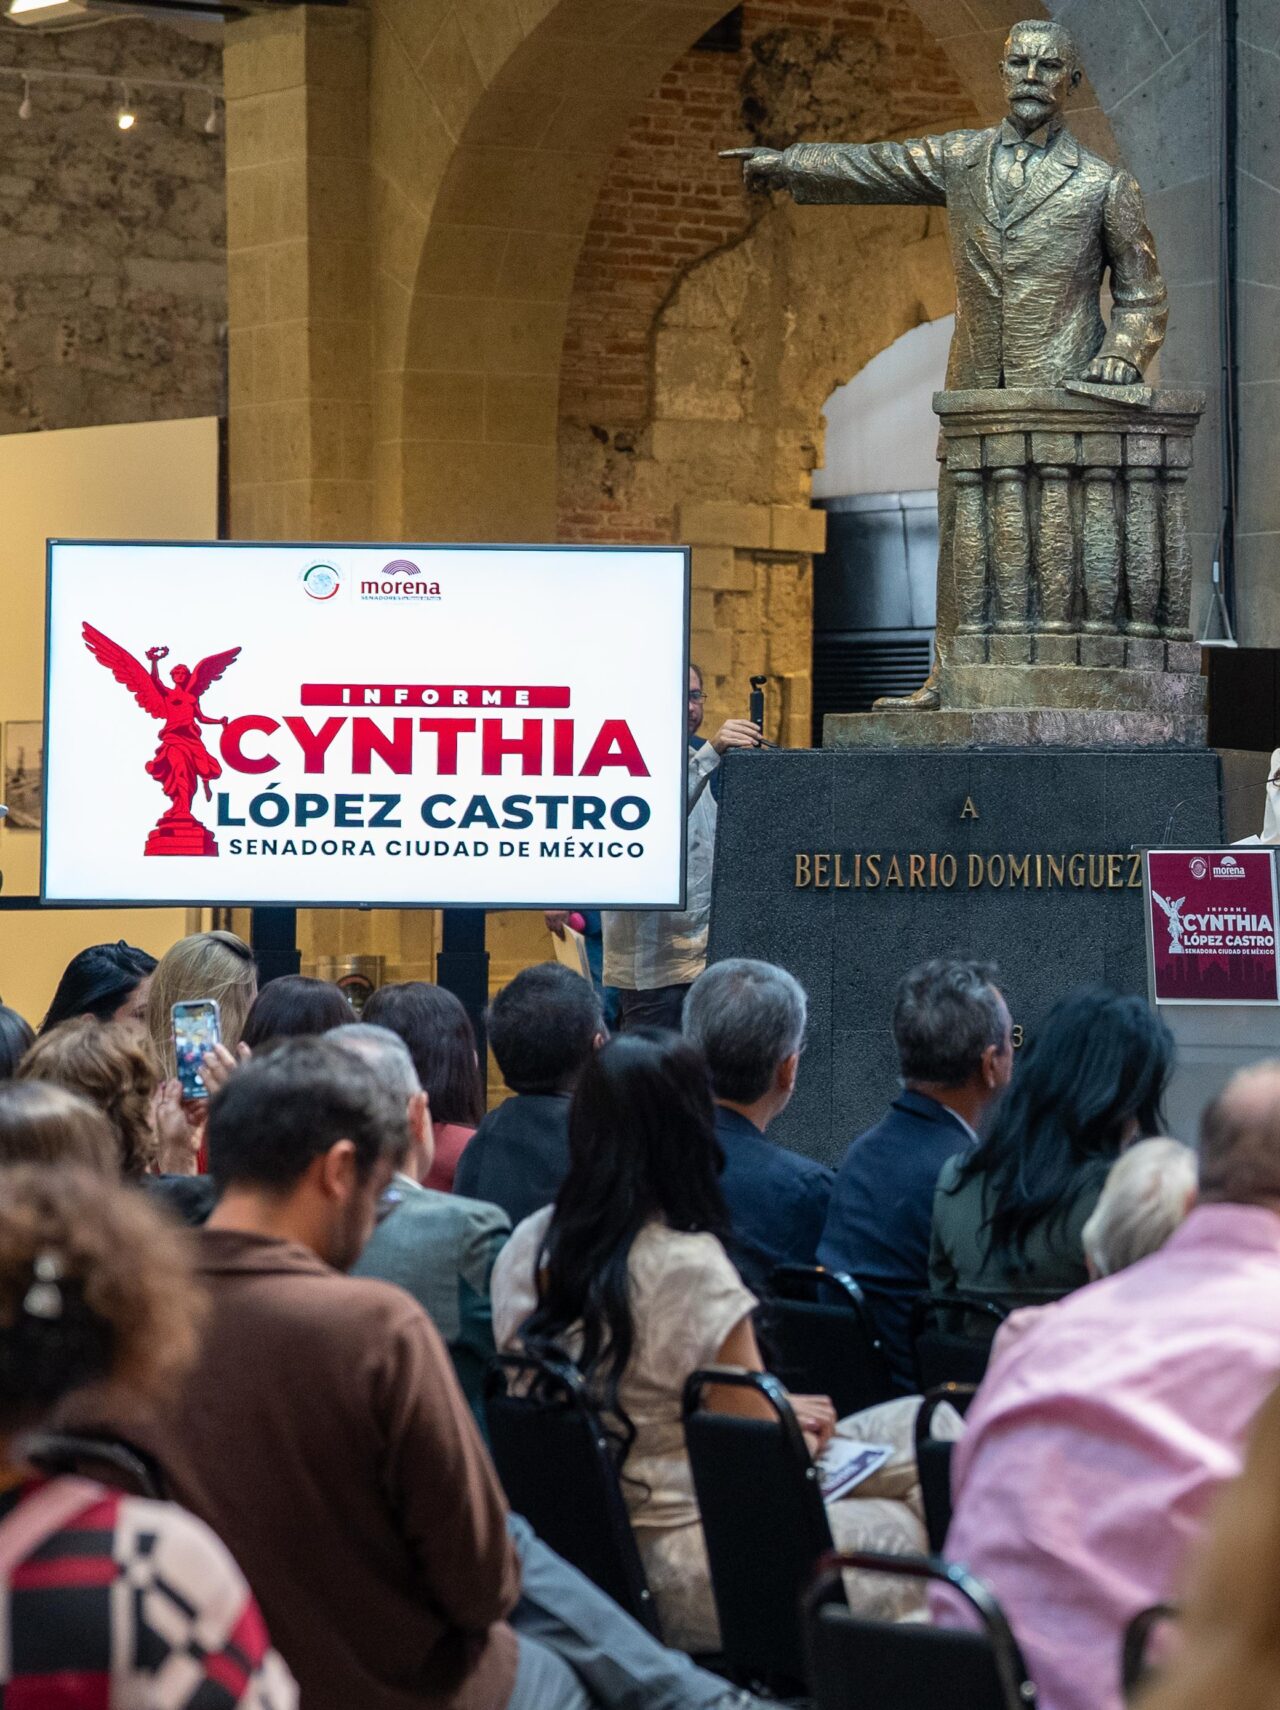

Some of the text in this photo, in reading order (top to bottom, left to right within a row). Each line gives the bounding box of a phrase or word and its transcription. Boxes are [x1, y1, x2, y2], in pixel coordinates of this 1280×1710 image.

[361, 581, 441, 595] morena
[342, 688, 530, 706] INFORME
[219, 714, 651, 777] CYNTHIA
[217, 782, 651, 831] LÓPEZ CASTRO
[959, 796, 980, 818] A
[229, 836, 644, 858] SENADORA CIUDAD DE MÉXICO
[794, 853, 1142, 888] BELISARIO DOMINGUEZ
[1213, 867, 1245, 875] morena
[1183, 914, 1273, 931] CYNTHIA
[1184, 932, 1274, 946] LÓPEZ CASTRO
[1251, 947, 1275, 955] MÉXICO
